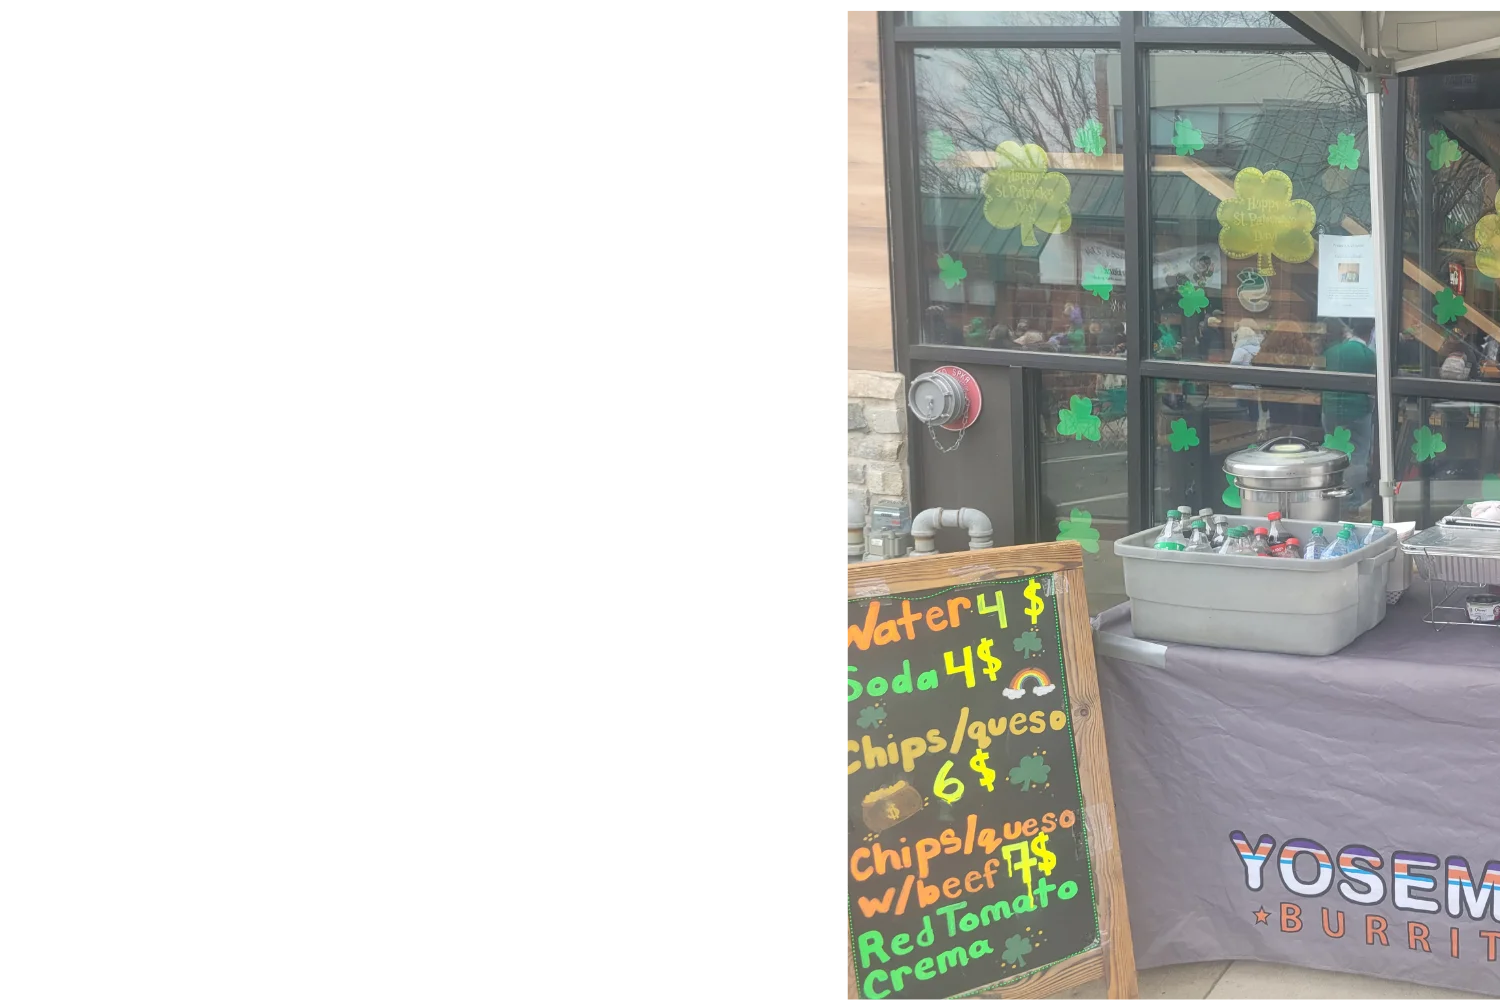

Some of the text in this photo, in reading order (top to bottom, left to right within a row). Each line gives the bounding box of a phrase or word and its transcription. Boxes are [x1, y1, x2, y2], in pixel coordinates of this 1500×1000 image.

[1247, 196, 1280, 212] Happy
[846, 597, 971, 650] Water
[850, 809, 1076, 881] Chips/queso
[858, 858, 1000, 918] w/beef
[863, 938, 994, 1000] Crema
